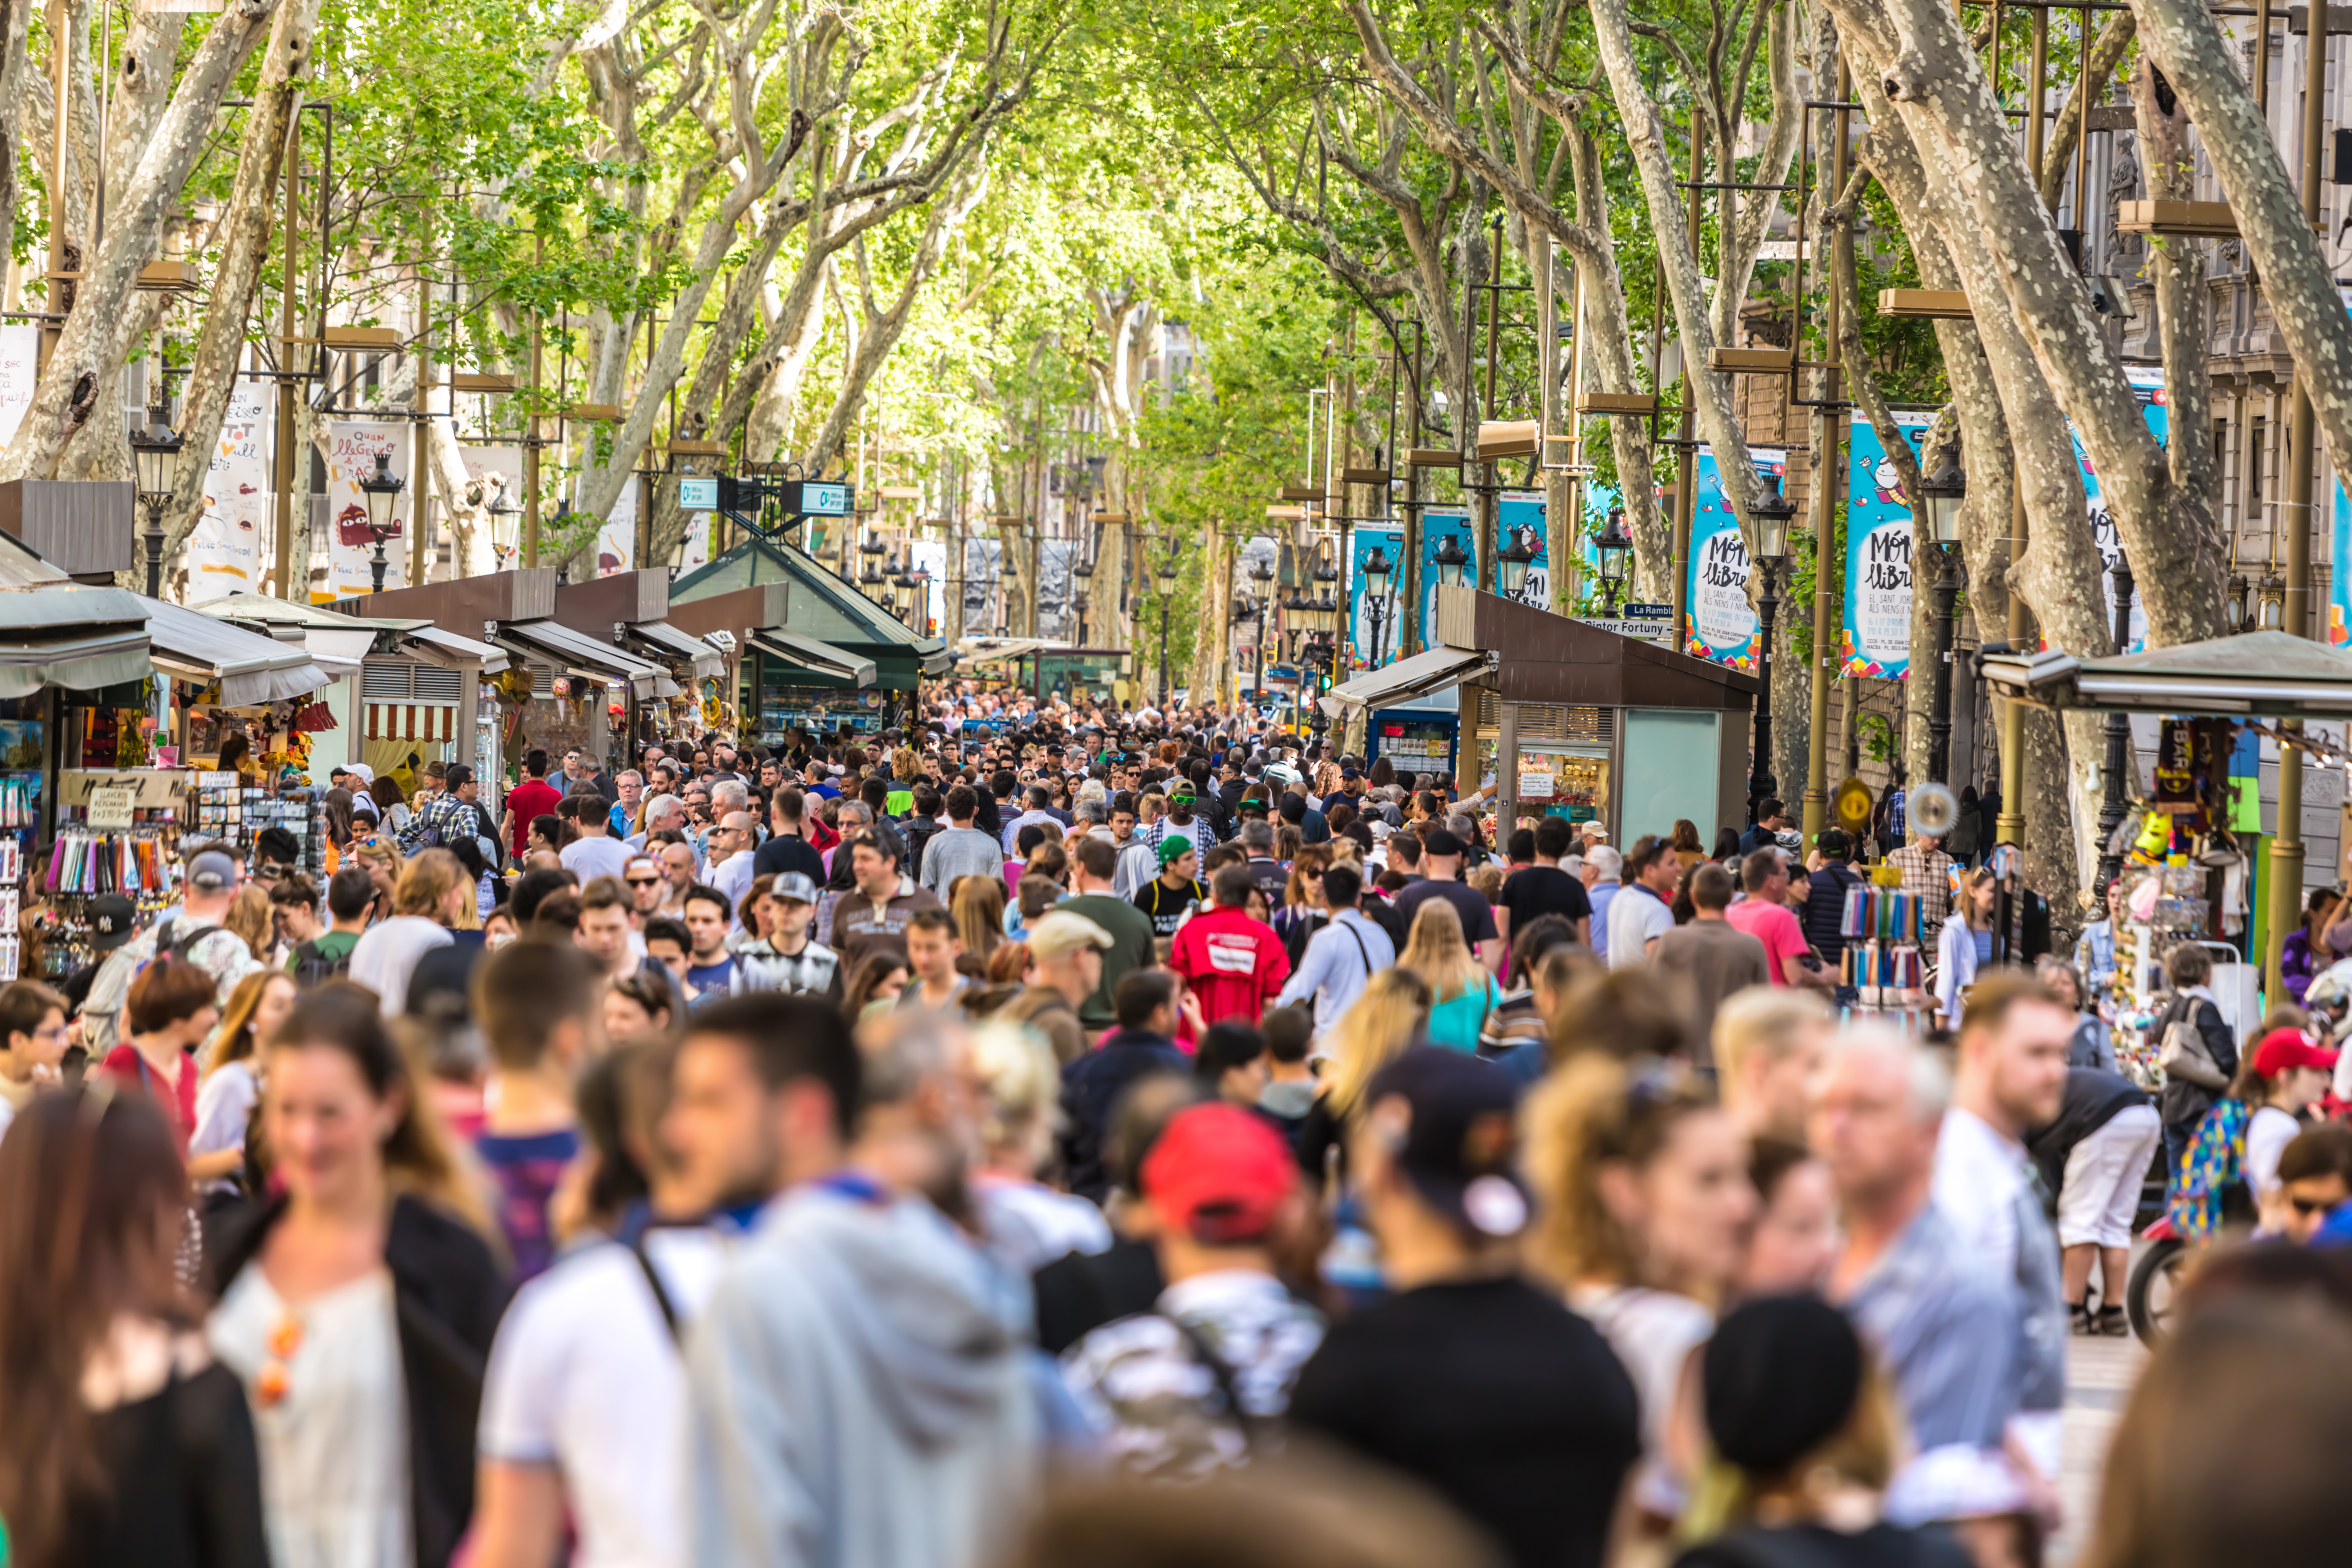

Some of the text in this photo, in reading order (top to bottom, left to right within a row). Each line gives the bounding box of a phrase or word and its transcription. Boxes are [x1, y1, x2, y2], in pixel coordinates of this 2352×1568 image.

[1705, 588, 1744, 602] EL SANT JORDI
[1869, 594, 1913, 605] EL SANT JORD
[1704, 596, 1713, 605] ALS
[1714, 599, 1729, 608] NENS
[1869, 604, 1879, 613] ALS
[1882, 605, 1900, 614] NENS
[1742, 615, 1753, 624] 2016
[1622, 622, 1663, 635] Fortuny
[1878, 627, 1882, 635] A
